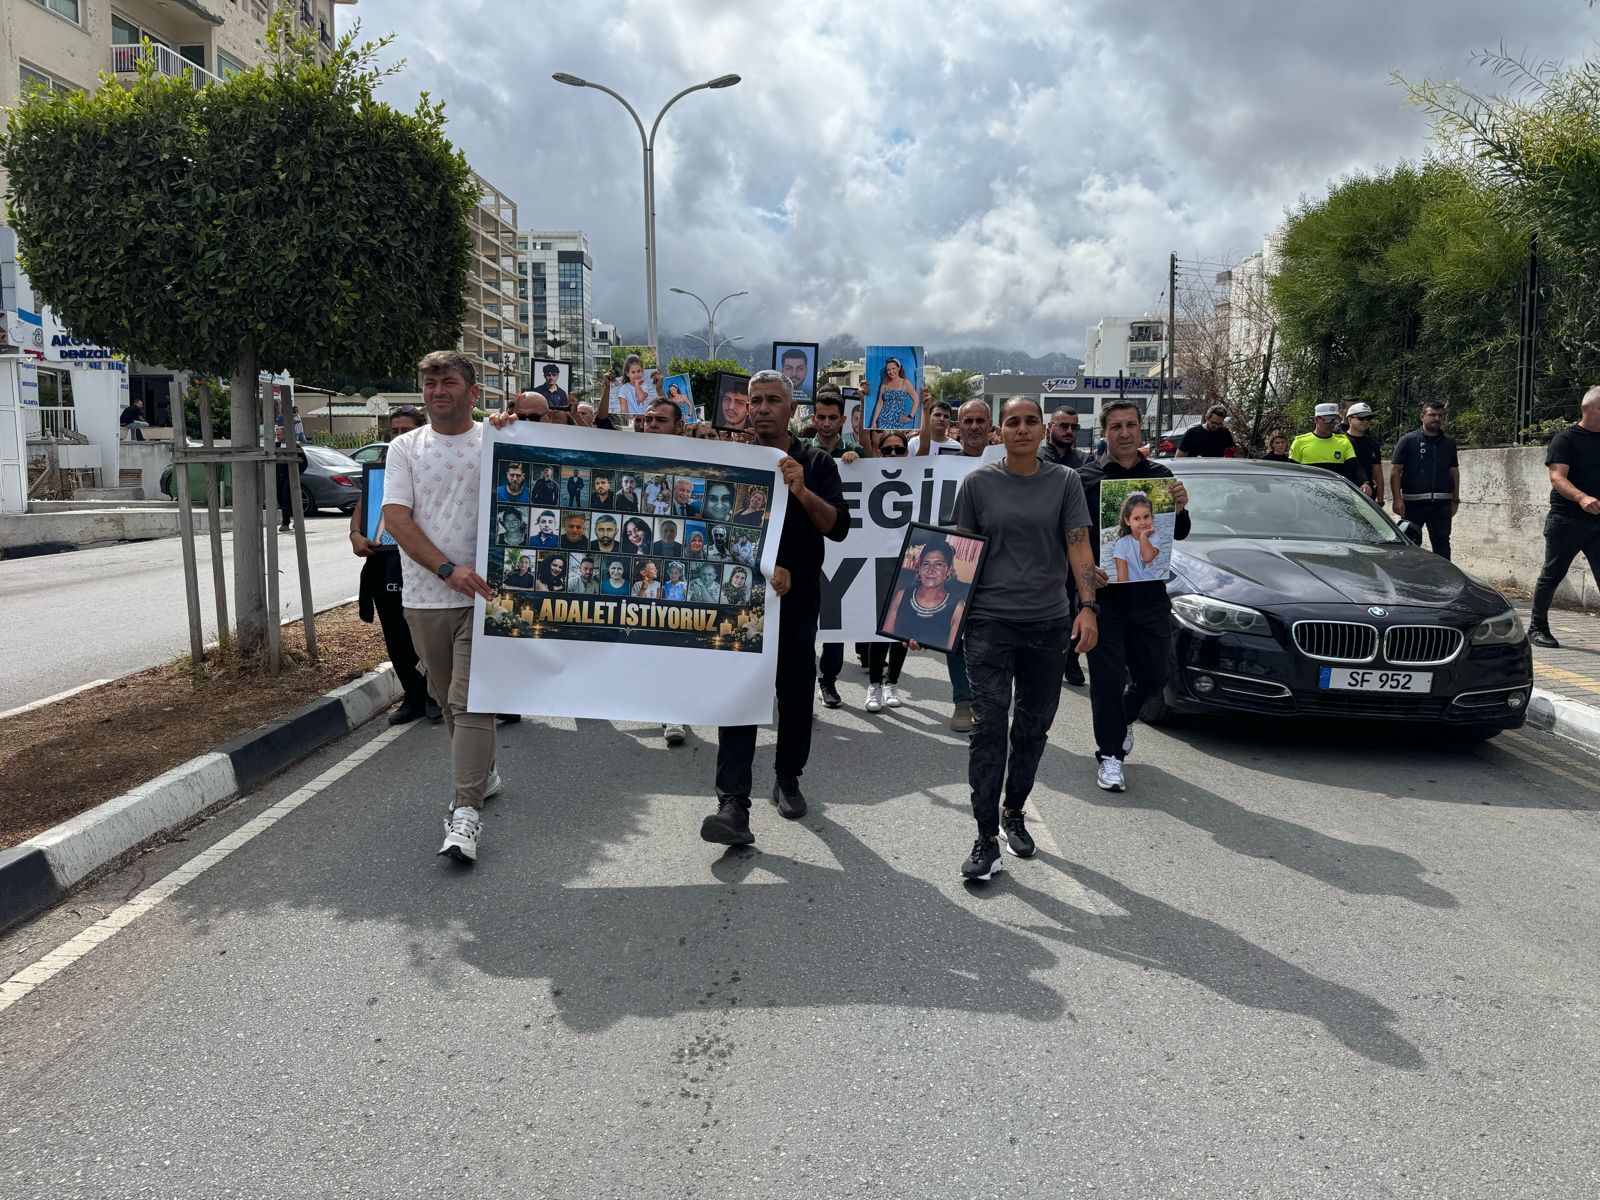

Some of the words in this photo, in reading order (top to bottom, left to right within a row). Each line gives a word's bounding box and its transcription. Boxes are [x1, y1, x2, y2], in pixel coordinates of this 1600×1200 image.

[539, 598, 618, 625] ADALET
[620, 599, 718, 632] İSTİYORUZ
[1347, 671, 1374, 688] SF
[1378, 672, 1413, 690] 952
